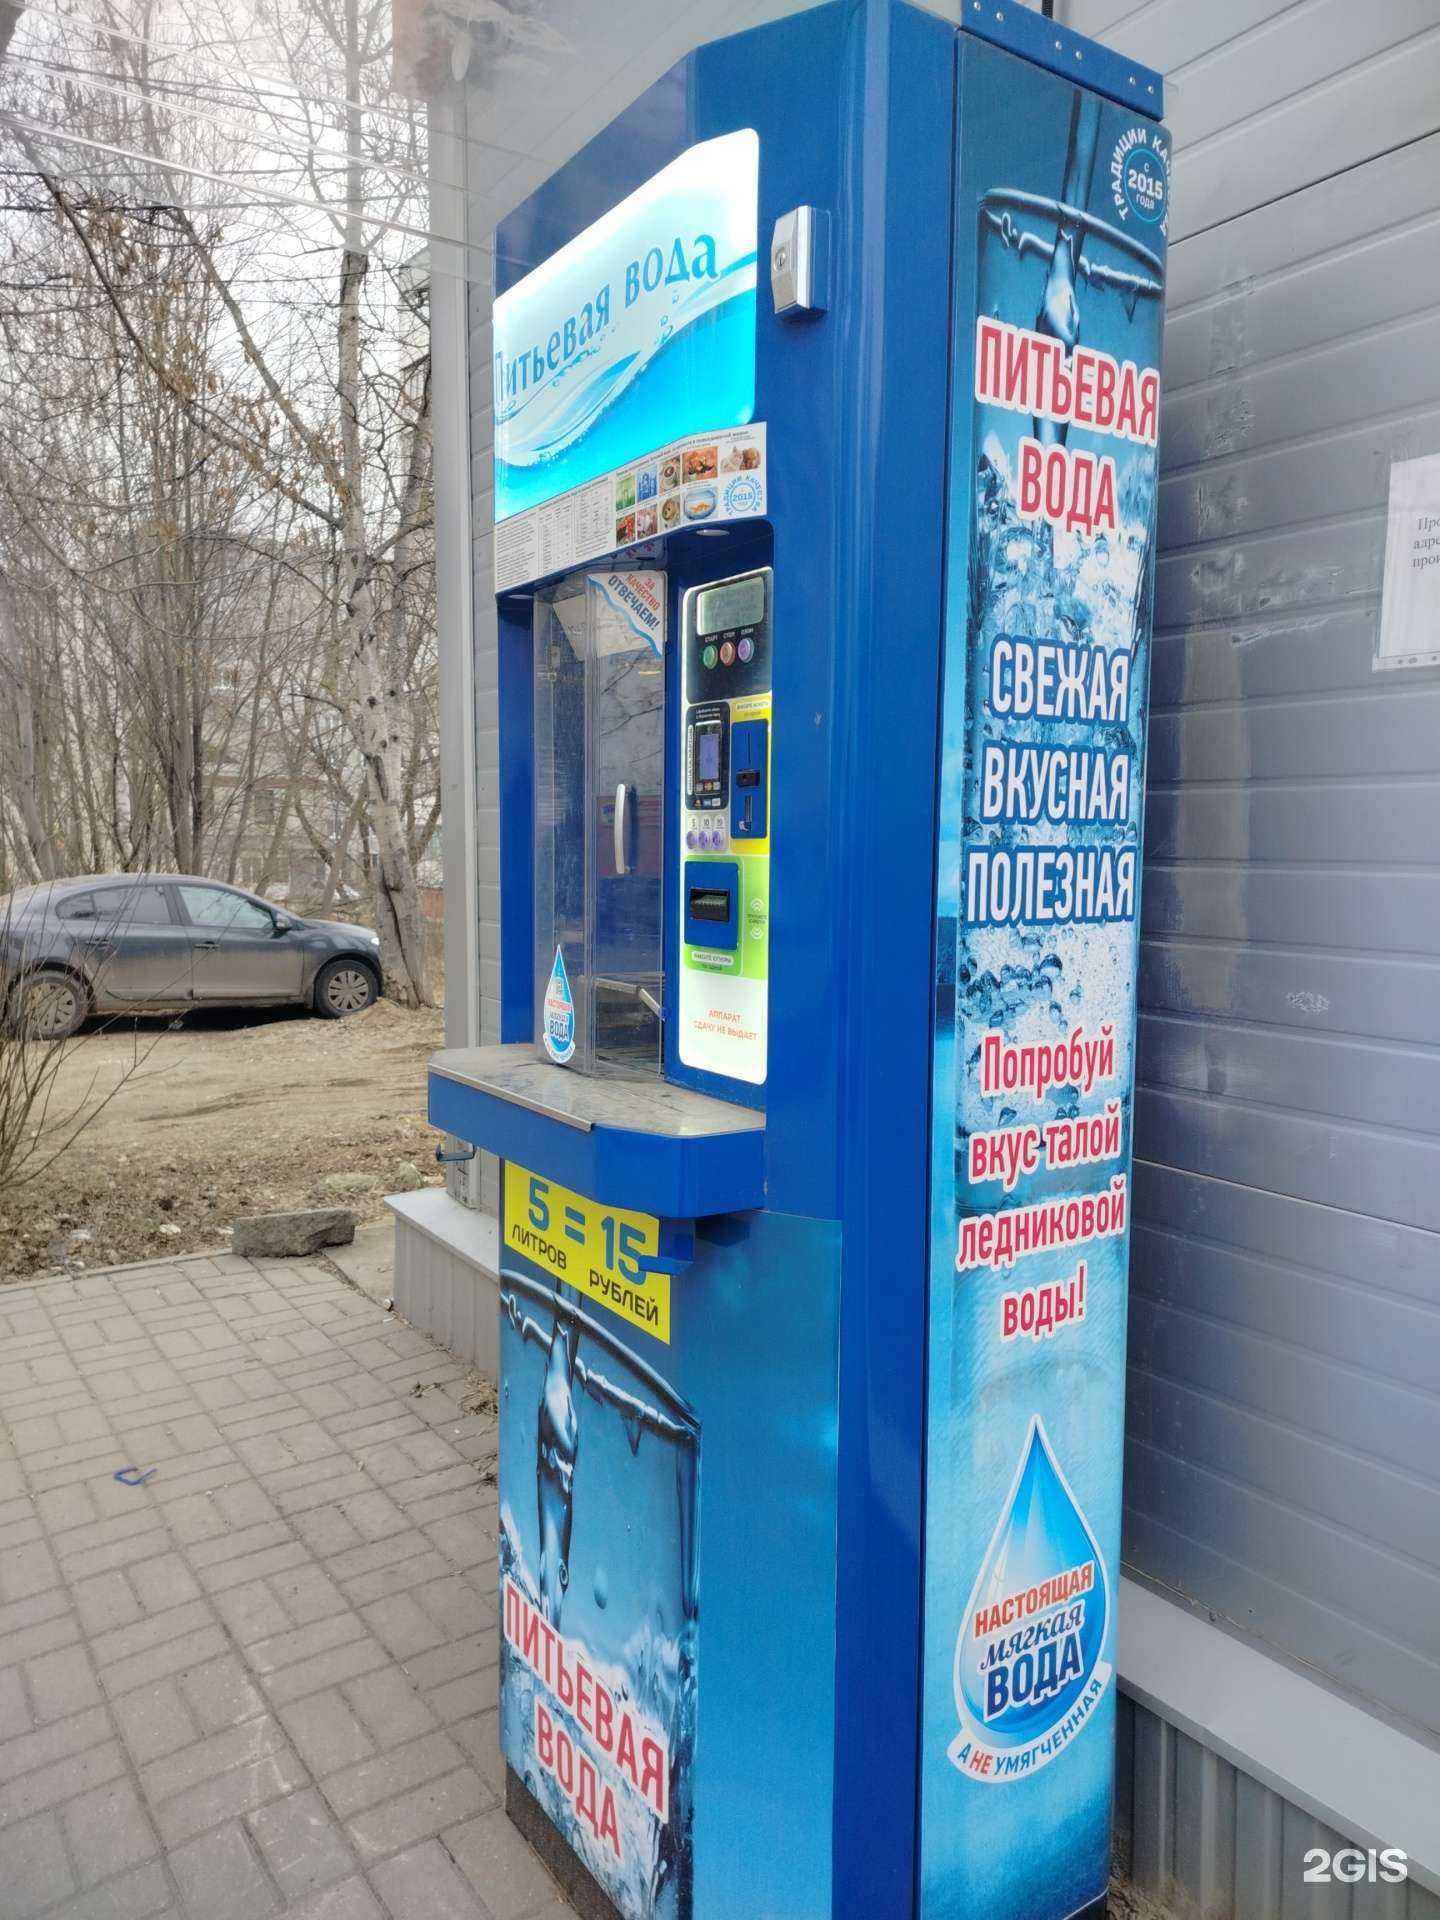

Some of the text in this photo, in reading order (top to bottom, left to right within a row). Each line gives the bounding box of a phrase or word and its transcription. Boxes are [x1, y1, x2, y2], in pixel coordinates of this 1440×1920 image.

[1111, 128, 1147, 221] ТРАДИЦИИ
[1128, 169, 1163, 200] 2015
[1136, 193, 1155, 210] года
[979, 325, 1158, 440] ПИТЬЕВАЯ
[1020, 444, 1116, 537] ВОДА
[608, 574, 661, 631] ОТВЕЧАЕМ!
[992, 640, 1129, 722] СВЕЖАЯ
[983, 747, 1129, 820] ВКУСНАЯ
[967, 851, 1136, 922] ПОЛЕЗНАЯ
[984, 1025, 1114, 1098] Попробуй
[971, 1103, 1120, 1186] вкус талой
[512, 1223, 567, 1270] ЛИТРОВ
[528, 1176, 549, 1232] 5
[601, 1215, 647, 1286] 15
[958, 1179, 1126, 1266] ледниковой
[589, 1270, 659, 1326] РУБЛЕЙ
[1003, 1266, 1085, 1337] воды!
[975, 1564, 1093, 1637] НАСТОЯЩАЯ
[980, 1604, 1083, 1670] мягкая
[507, 1584, 664, 1813] ПИТЬЕВАЯ
[987, 1633, 1082, 1718] ВОДА
[958, 1678, 1103, 1776] А НЕ УМЯГЧЕННАЯ
[538, 1702, 622, 1858] ВОДА
